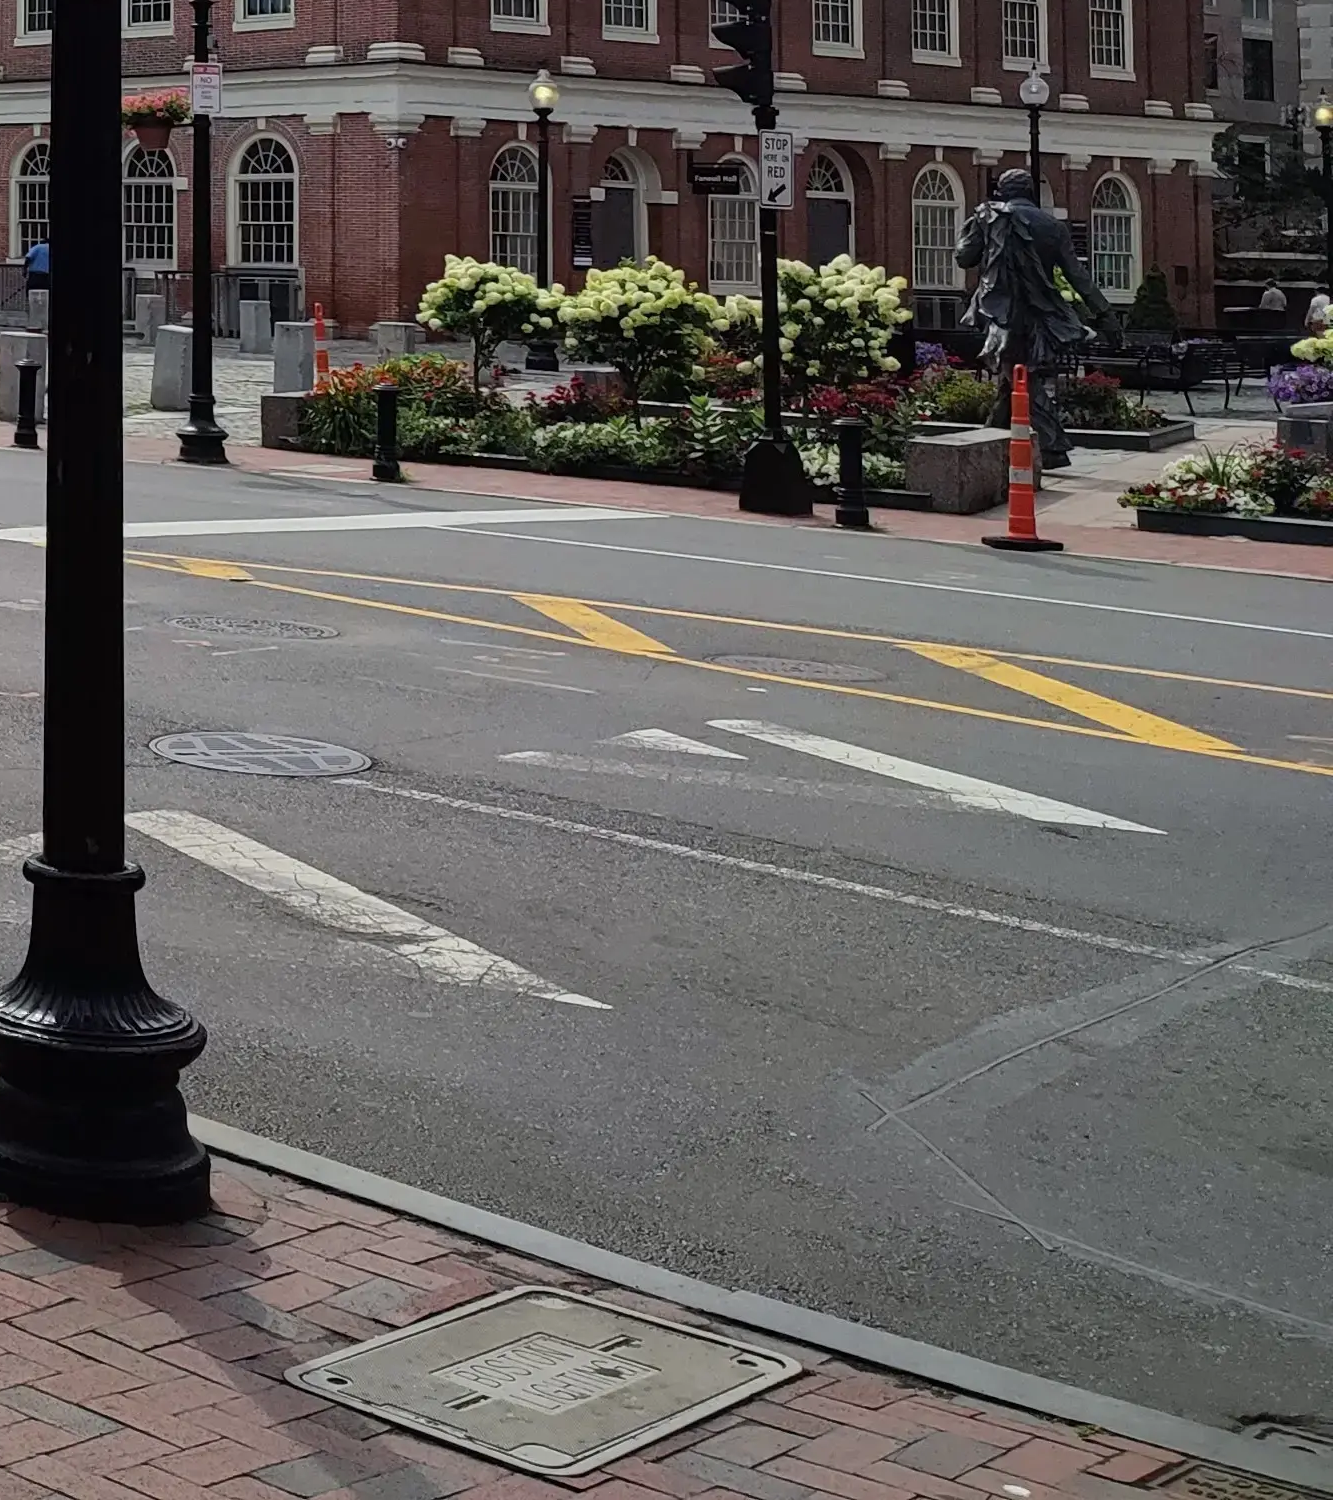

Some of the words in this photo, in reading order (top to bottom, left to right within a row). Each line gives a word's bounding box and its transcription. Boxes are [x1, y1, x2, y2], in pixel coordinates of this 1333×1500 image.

[764, 138, 789, 150] STOP
[764, 154, 777, 162] HERE
[767, 166, 786, 178] RED
[454, 1343, 574, 1389] BOSTON
[509, 1360, 637, 1410] LIGHTING
